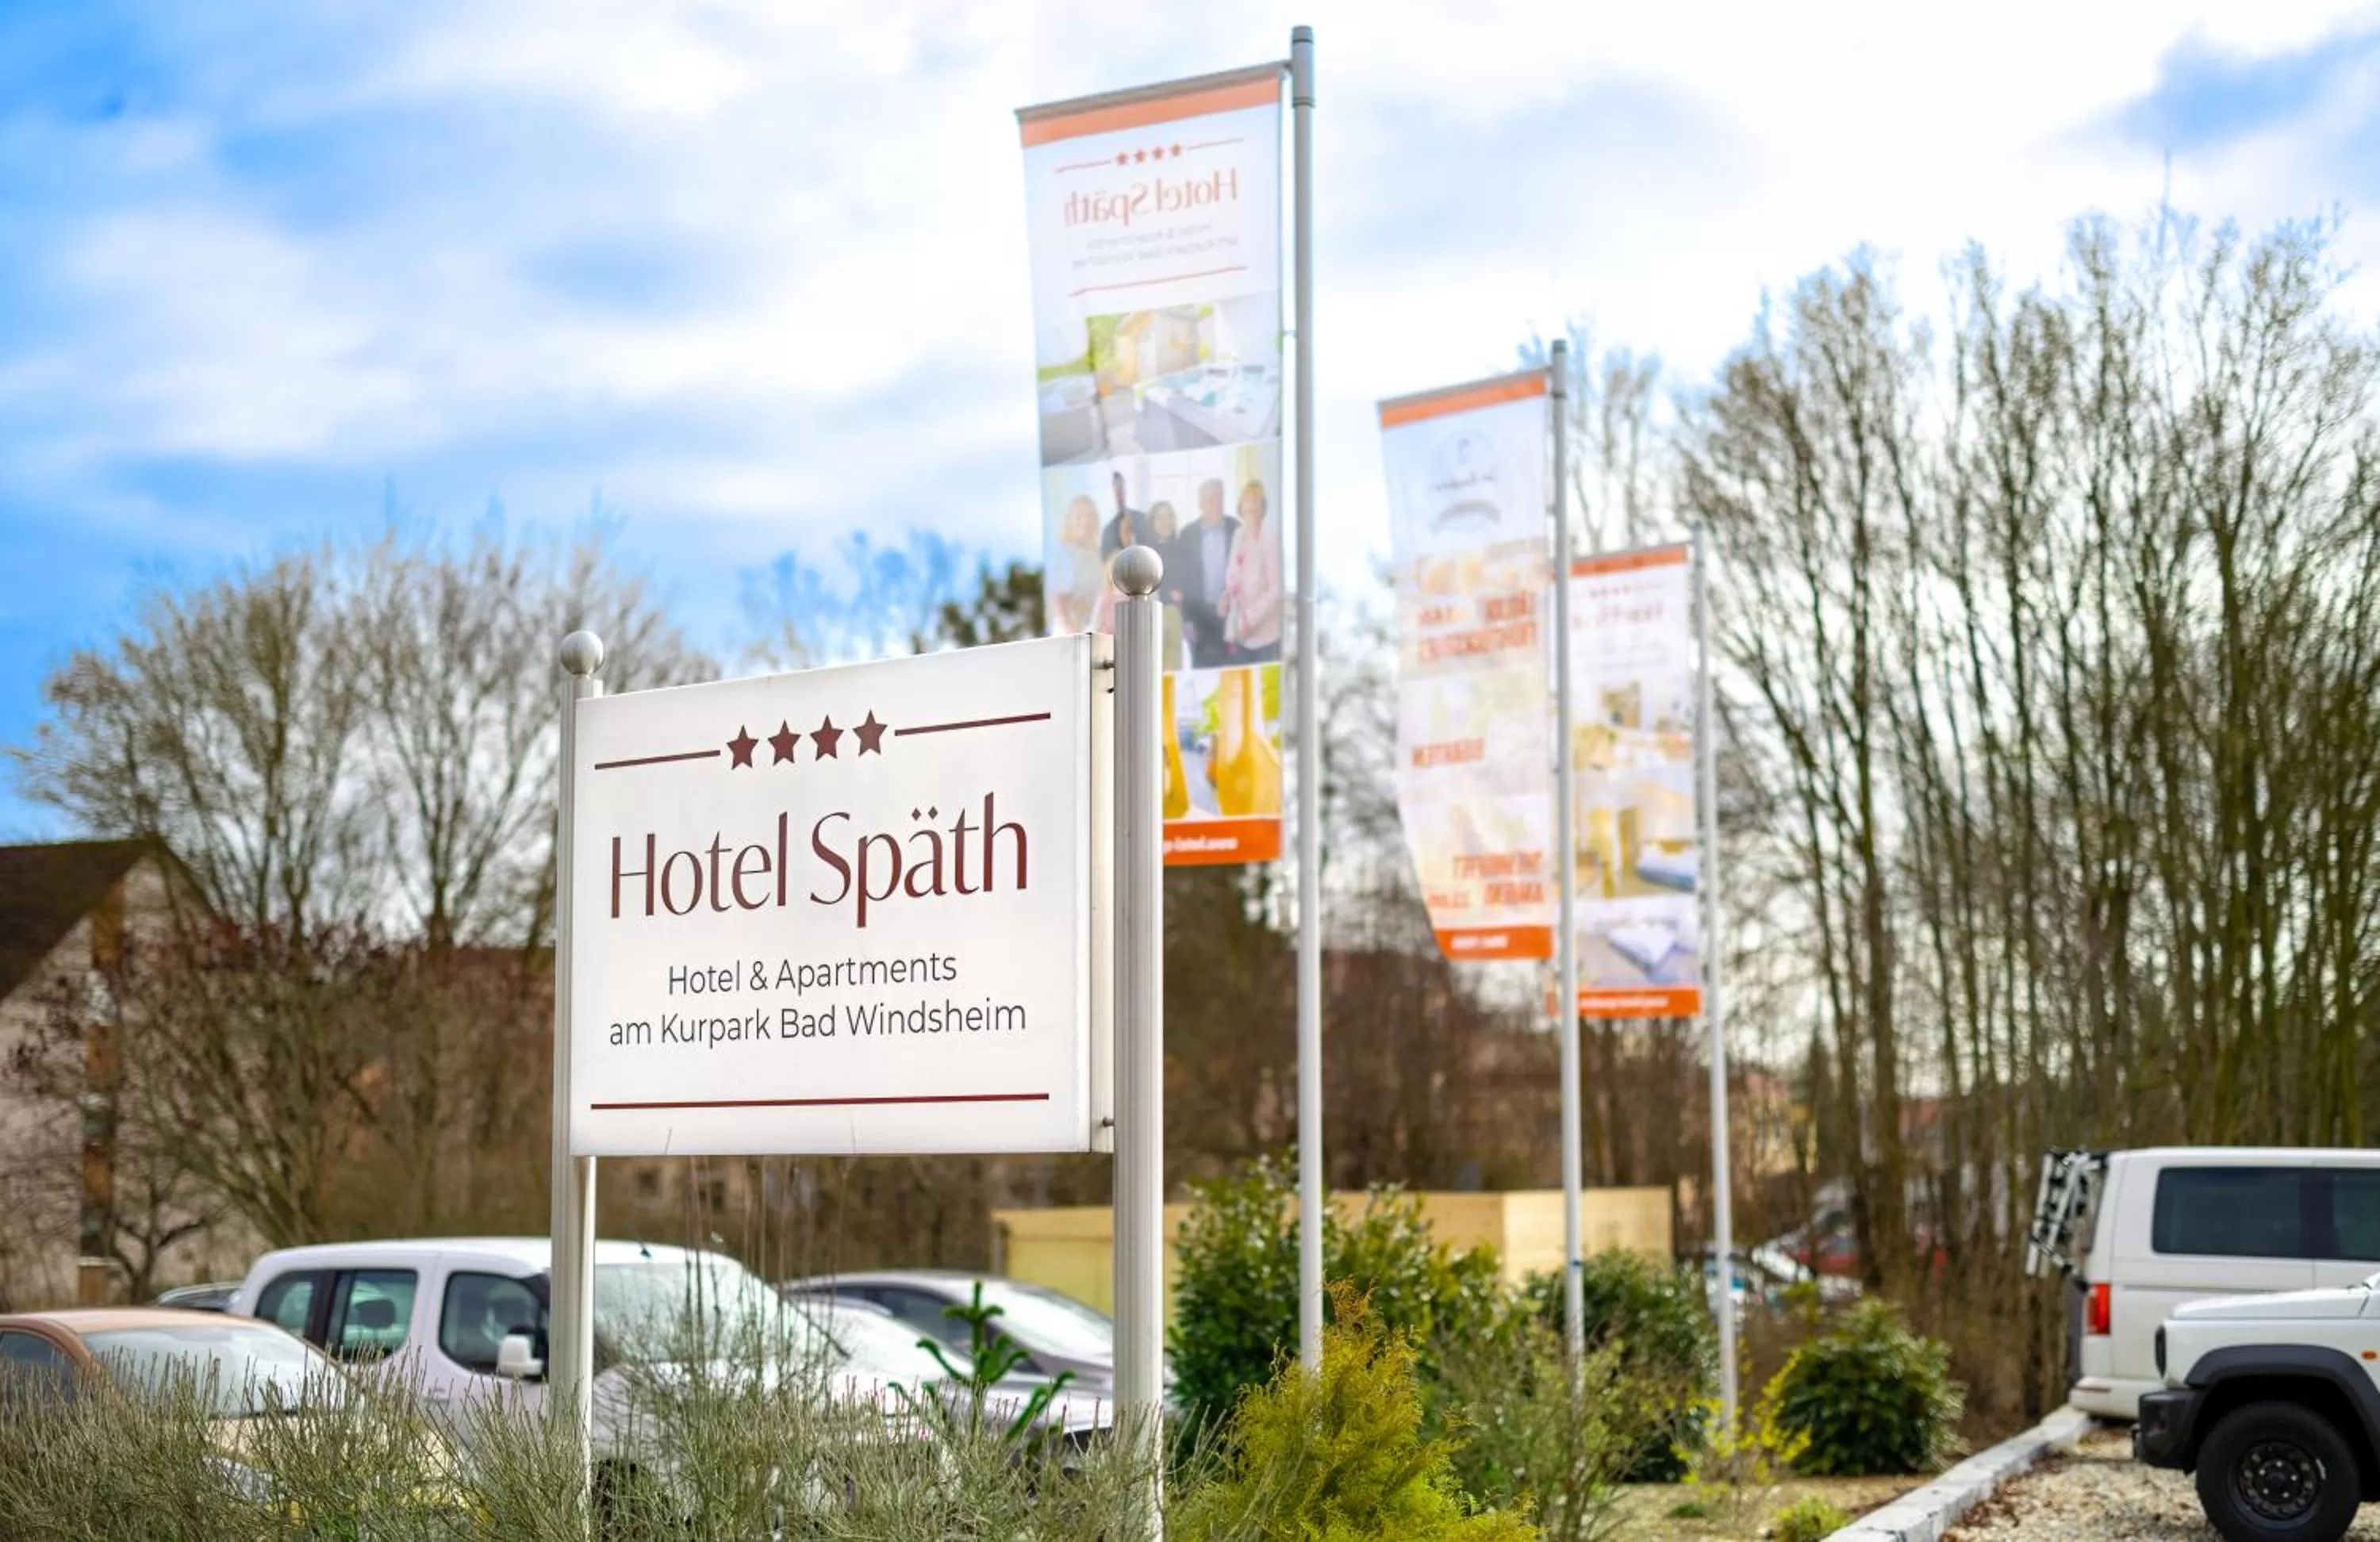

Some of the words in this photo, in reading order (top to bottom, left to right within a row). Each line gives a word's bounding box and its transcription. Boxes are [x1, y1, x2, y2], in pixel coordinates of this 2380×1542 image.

[610, 811, 789, 919] Hotel
[809, 791, 1028, 929] Späth
[669, 959, 741, 995] Hotel
[749, 960, 769, 992] &
[774, 952, 958, 997] Apartments
[609, 1021, 652, 1046] am
[661, 1007, 772, 1050] Kurpark
[780, 1003, 837, 1039] Bad
[845, 996, 1027, 1038] Windsheim
